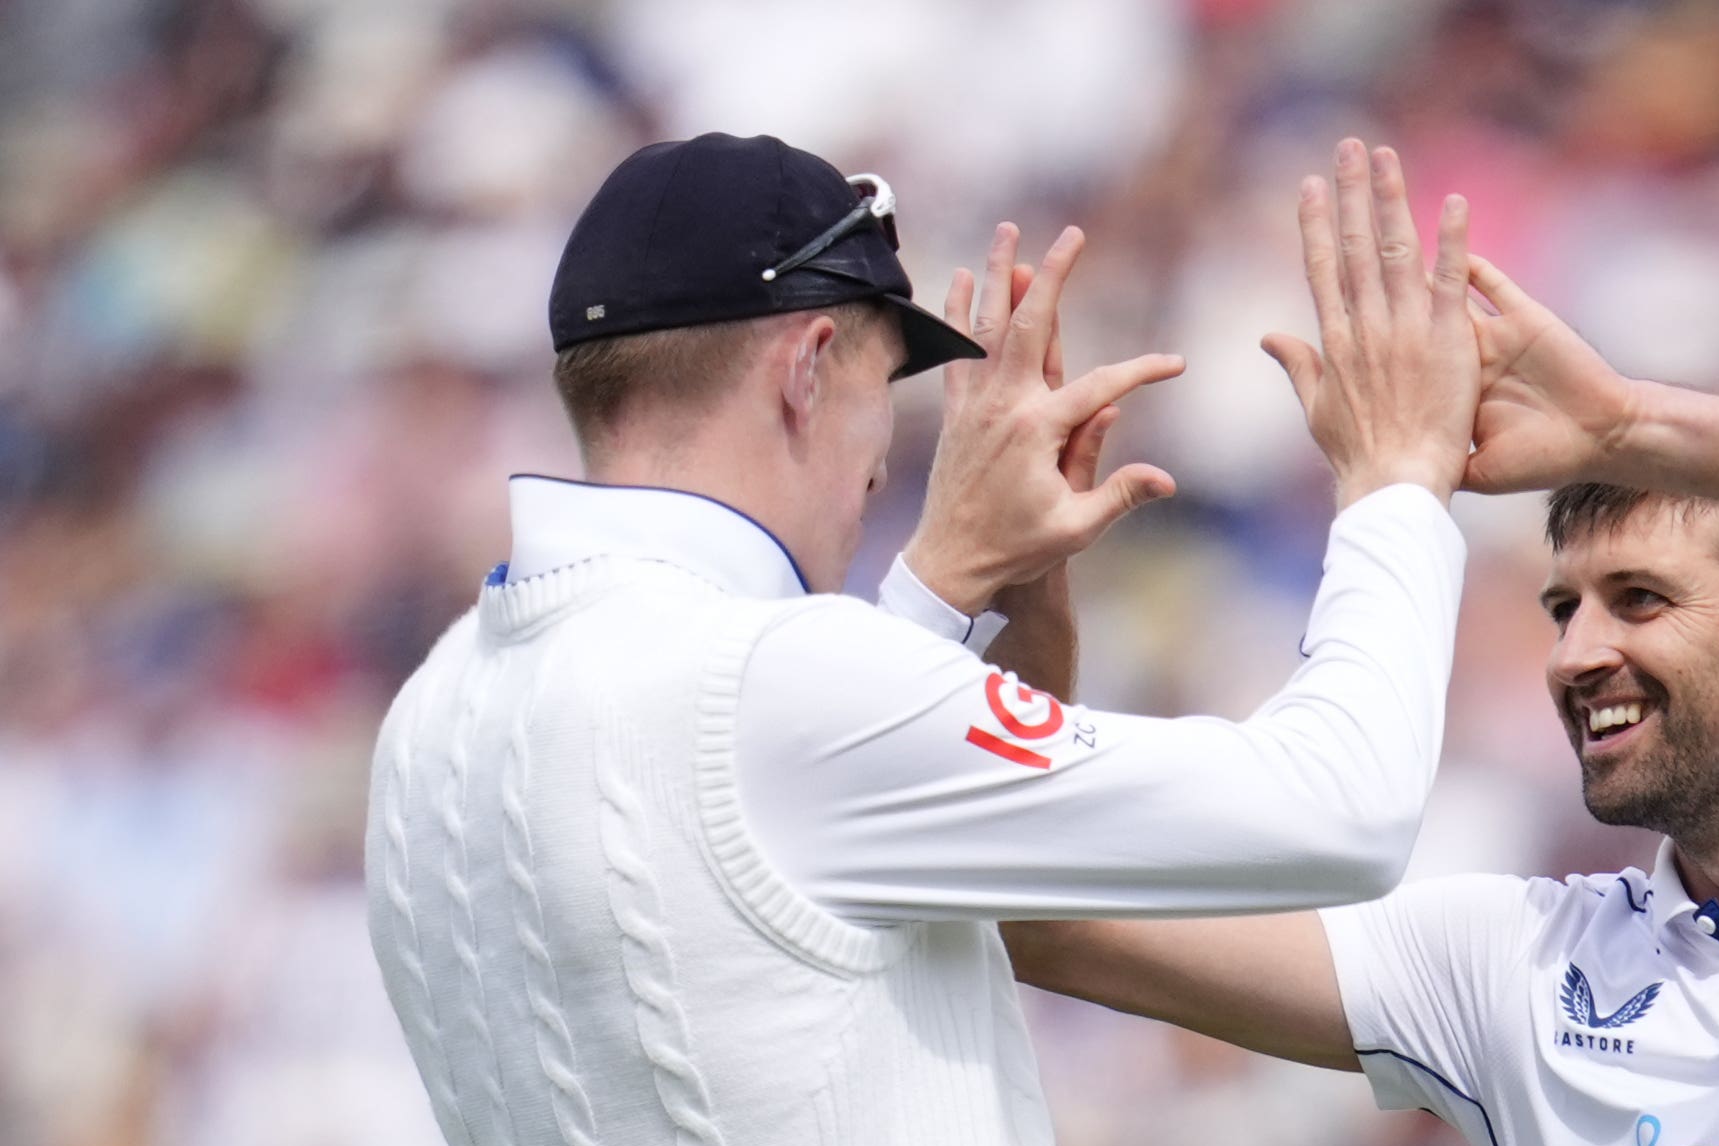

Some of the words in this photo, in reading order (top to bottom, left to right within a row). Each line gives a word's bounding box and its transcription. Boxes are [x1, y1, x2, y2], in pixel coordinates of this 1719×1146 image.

[965, 672, 1064, 769] IG
[1074, 722, 1096, 749] ZC
[1554, 1030, 1634, 1054] ASTORE
